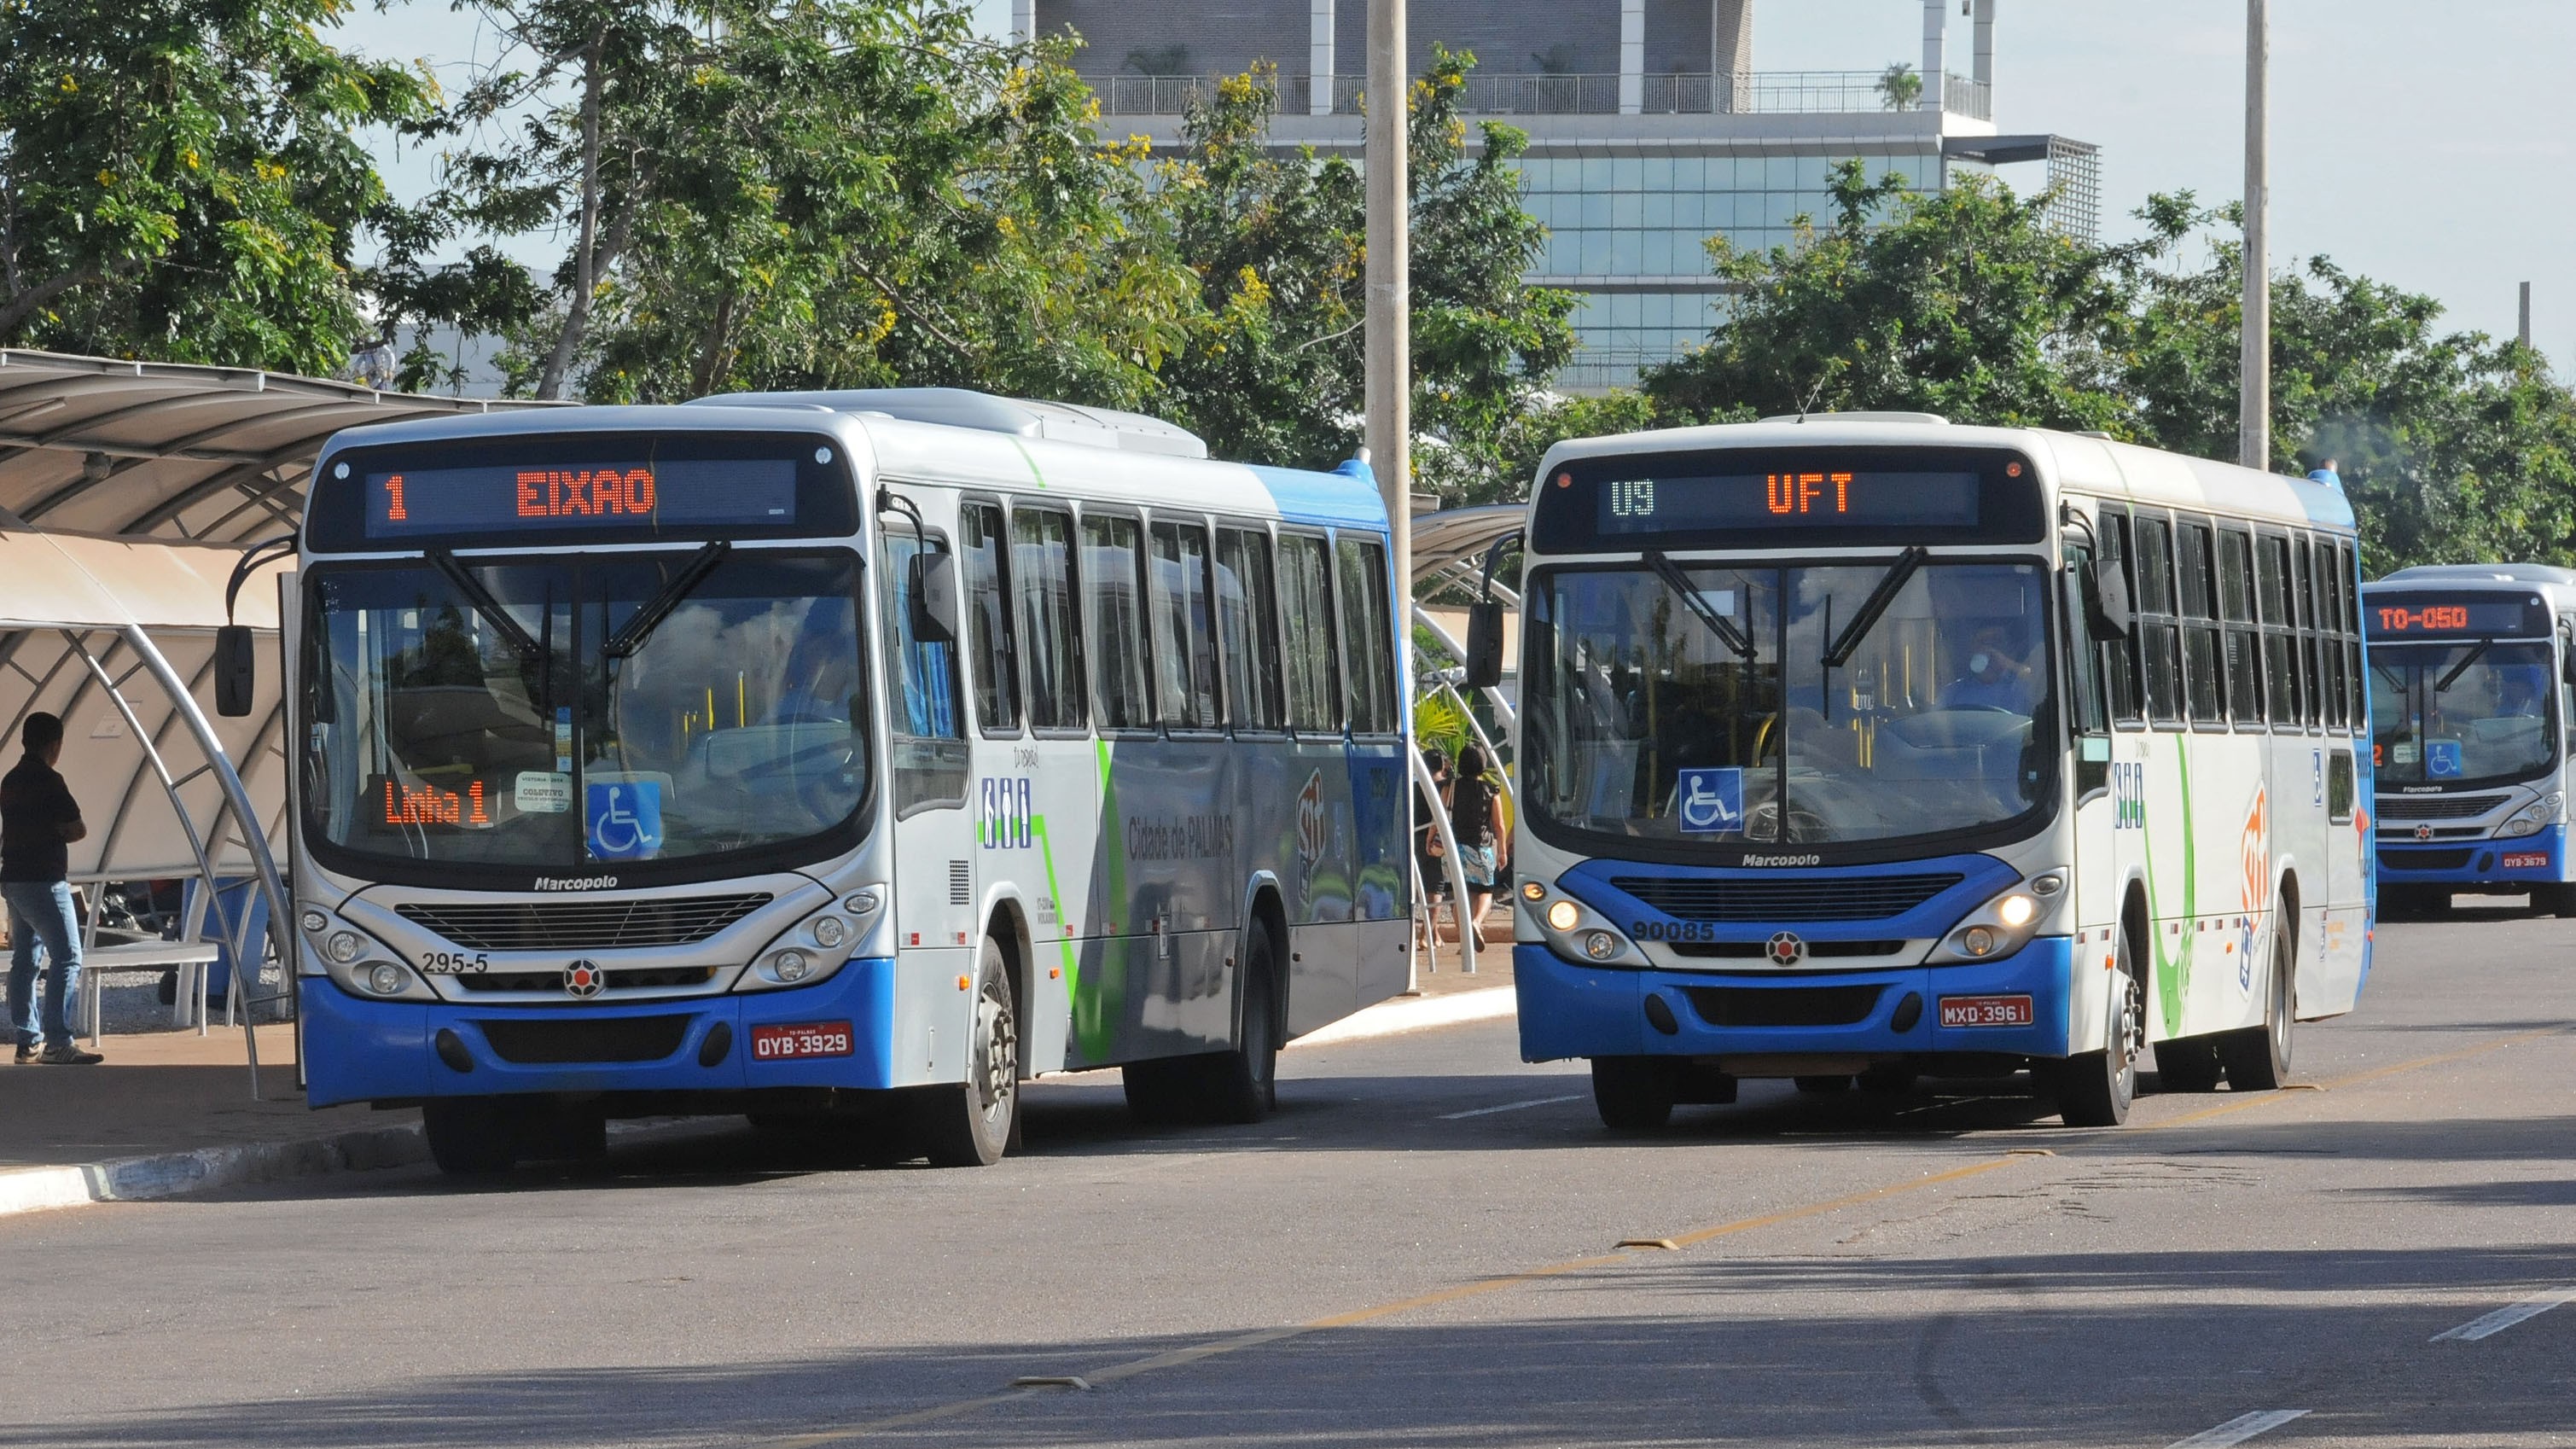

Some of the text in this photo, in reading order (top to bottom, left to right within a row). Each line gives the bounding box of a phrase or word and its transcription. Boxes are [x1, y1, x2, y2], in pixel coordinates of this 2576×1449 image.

[386, 468, 654, 520] 1 EIXAO
[1613, 471, 1853, 515] U9 UFT
[2380, 607, 2468, 631] TO-050
[386, 780, 489, 824] Linha 1
[1129, 814, 1233, 861] Cidade de PALMAS
[1742, 853, 1820, 867] Marcopolo
[534, 875, 618, 891] Marcopolo
[1632, 921, 1714, 941] 90085
[422, 952, 488, 973] 295-5
